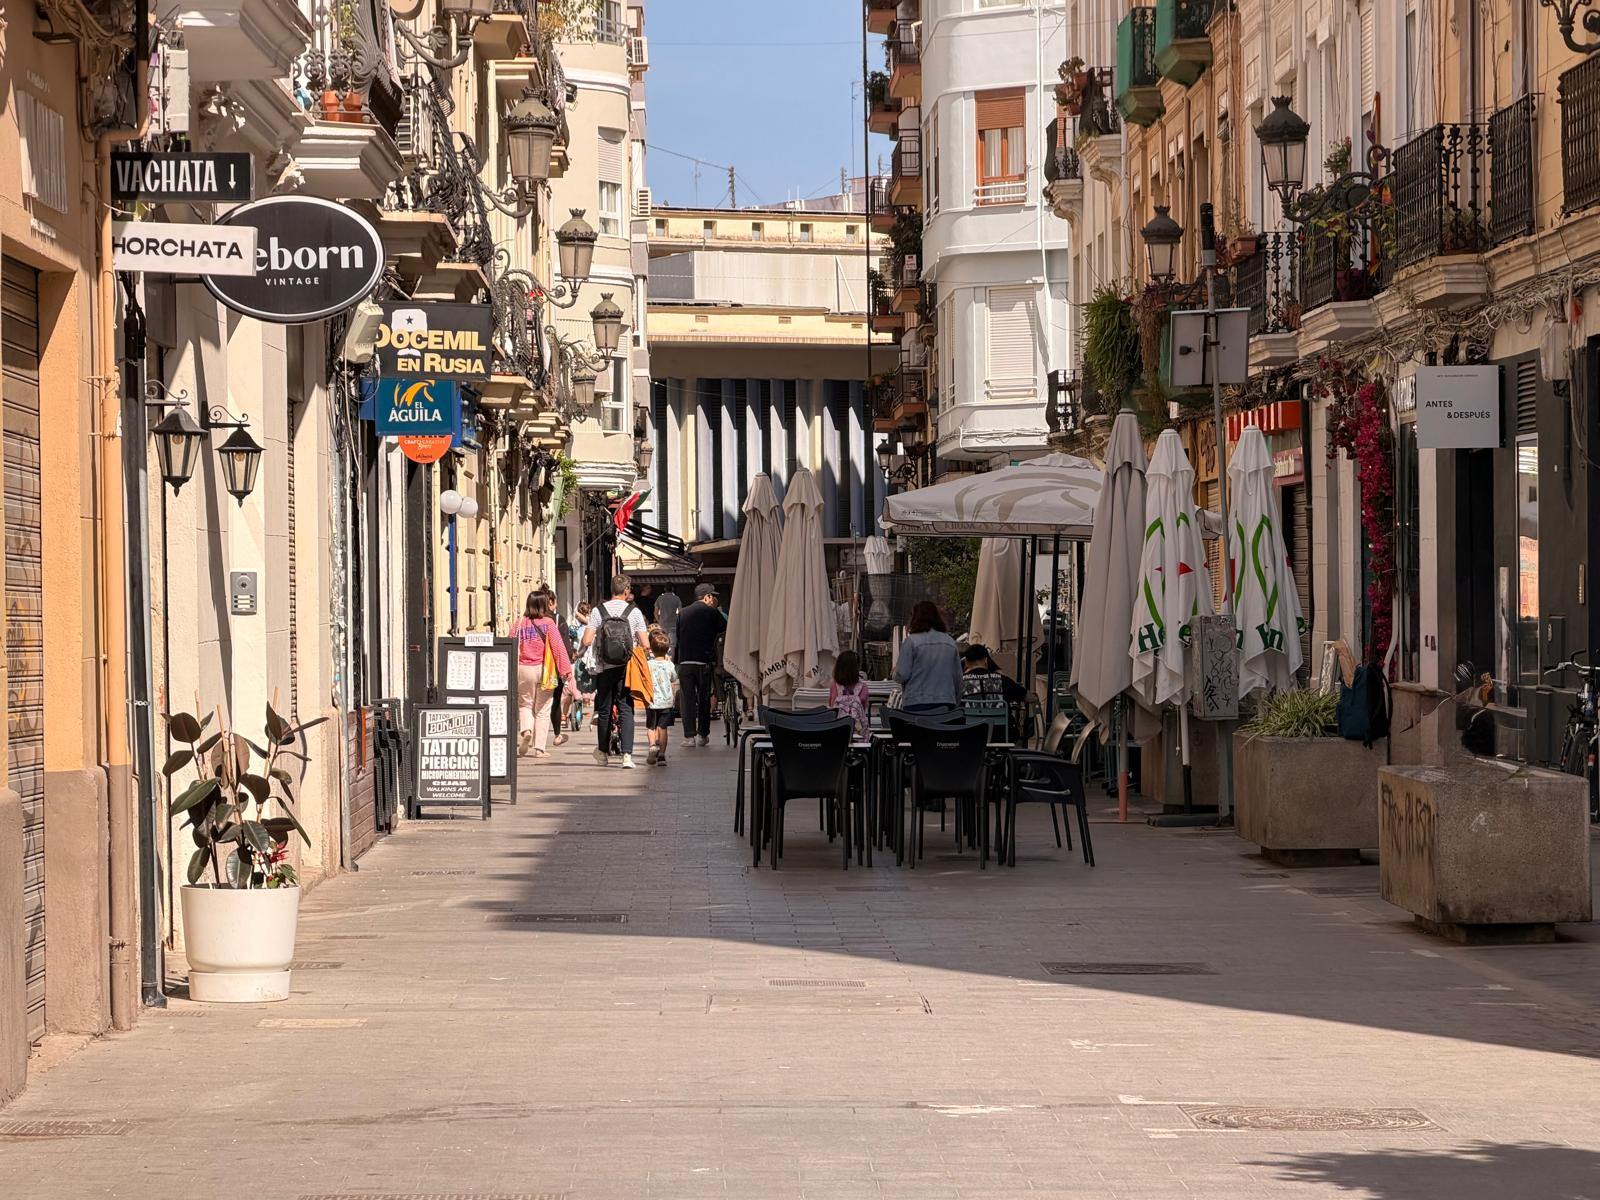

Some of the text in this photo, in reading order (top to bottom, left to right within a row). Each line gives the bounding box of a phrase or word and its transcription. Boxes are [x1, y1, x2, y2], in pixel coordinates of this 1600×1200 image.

[116, 160, 218, 192] VACHATA
[112, 237, 243, 259] HORCHATA
[256, 237, 364, 271] eborn
[265, 277, 320, 286] VINTAGE
[376, 323, 486, 351] DOCEMIL
[397, 358, 421, 372] EN
[415, 401, 424, 409] EL
[1425, 400, 1453, 408] ANTES
[388, 407, 442, 422] ÁGUILA
[429, 713, 475, 734] BONJOUR
[421, 738, 480, 756] TATTOO
[421, 756, 479, 770] PIERCING
